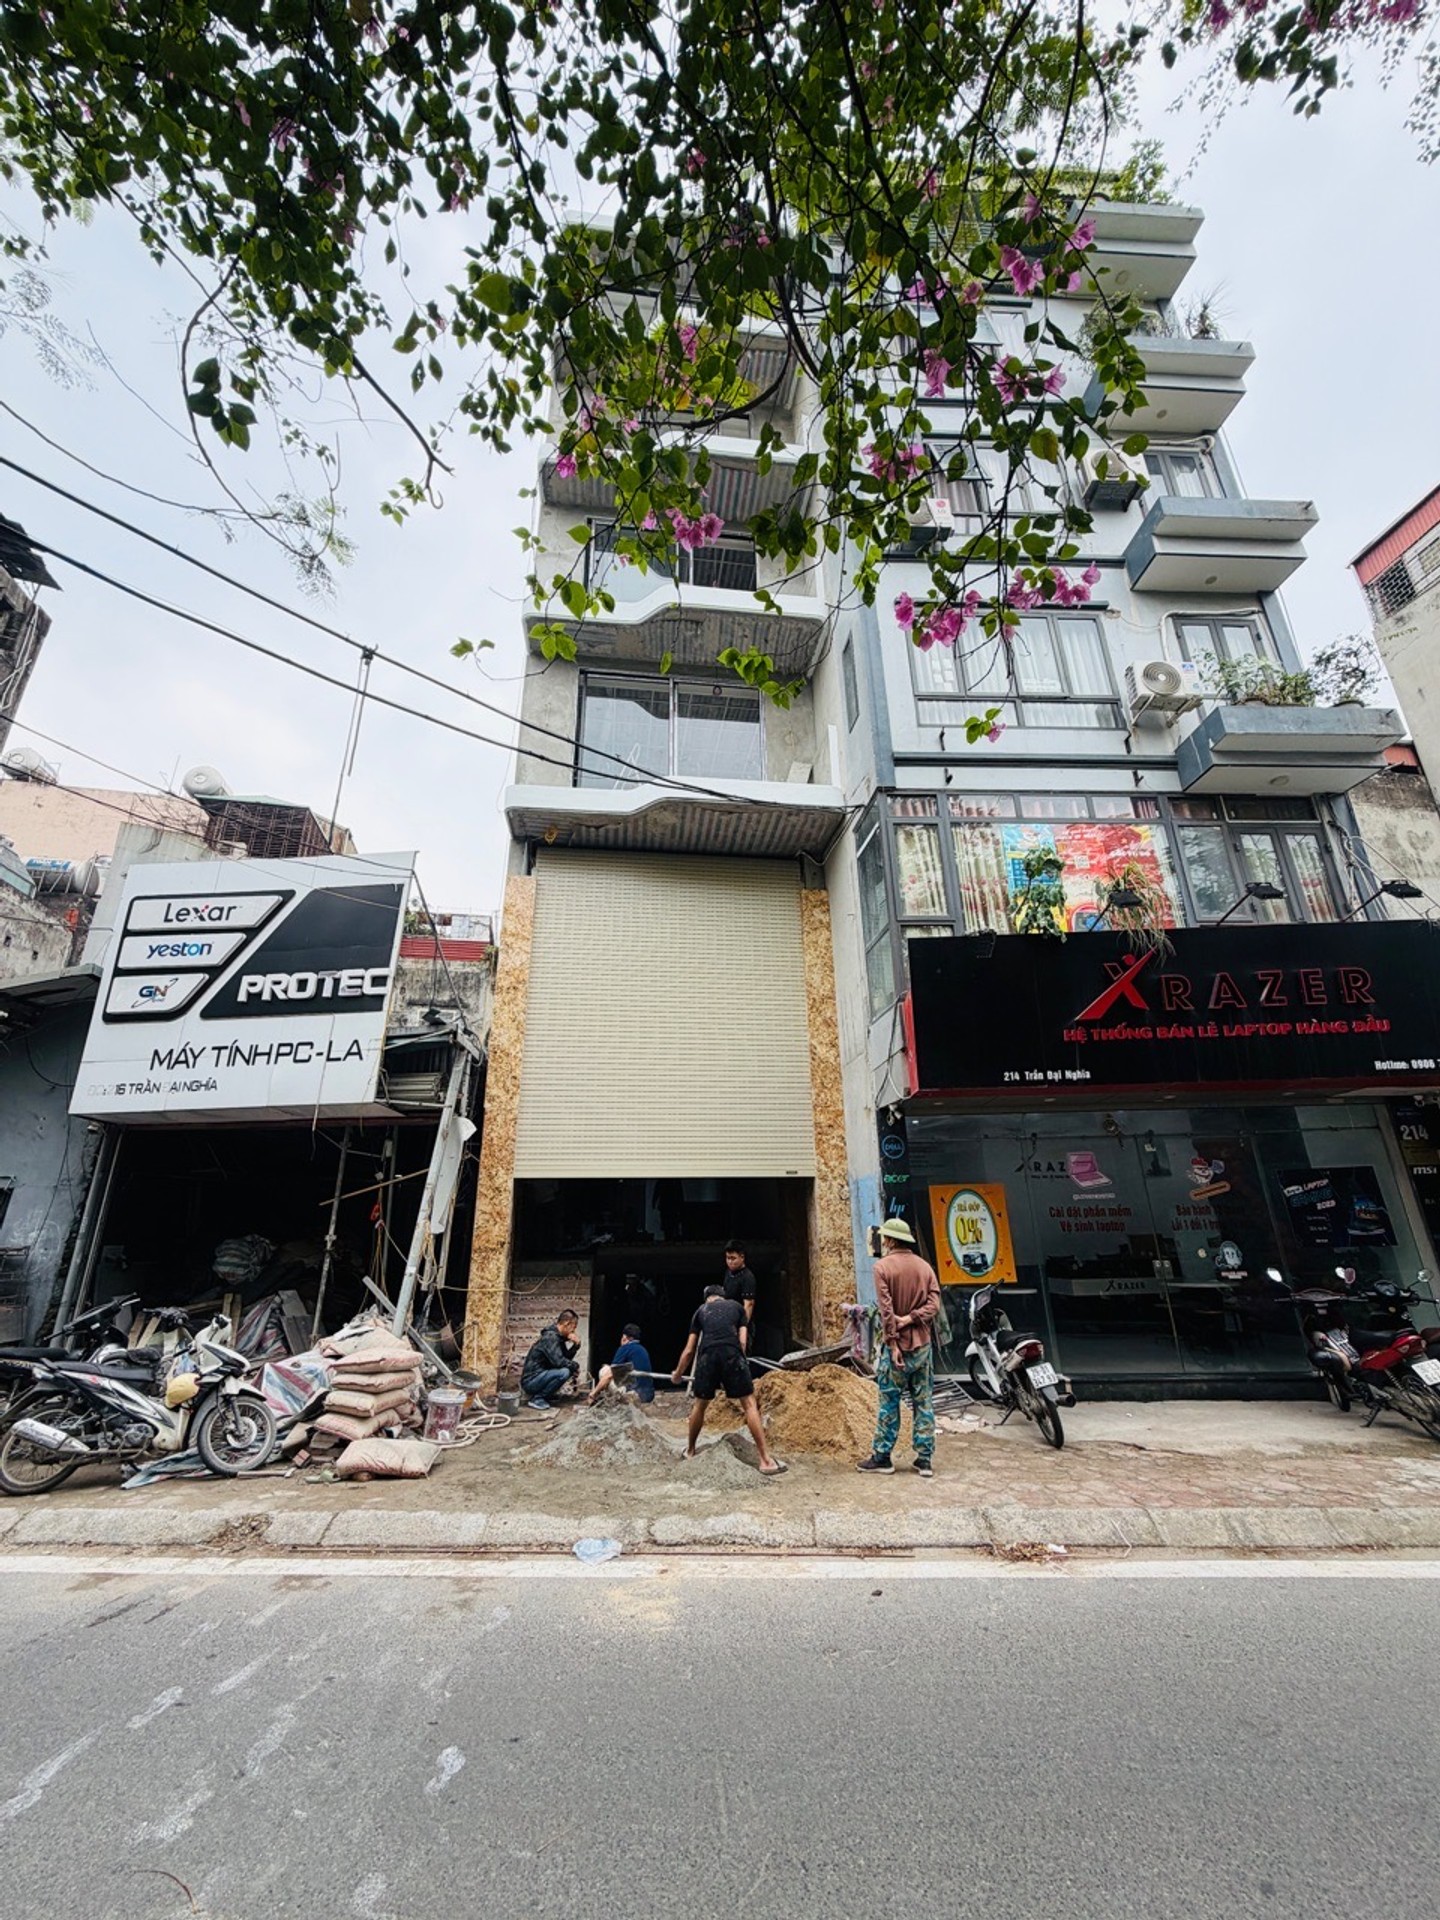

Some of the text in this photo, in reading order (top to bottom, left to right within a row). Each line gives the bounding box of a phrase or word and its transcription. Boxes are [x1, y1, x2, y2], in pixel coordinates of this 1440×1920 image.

[163, 903, 237, 923] Lexar
[147, 942, 213, 959] yeston
[1063, 1026, 1088, 1044] HỆ
[1091, 1022, 1153, 1041] THỐNG
[1156, 1023, 1195, 1039] BÁN
[1222, 1022, 1293, 1037] LAPTOP
[1296, 1018, 1350, 1035] HÀNG
[1352, 1014, 1391, 1033] ĐẦU
[149, 1039, 364, 1071] MÁY TÍNH PC-LA
[1003, 1071, 1020, 1081] 214
[128, 1077, 162, 1095] TRẦN
[181, 1076, 218, 1093] NGHĨA
[1400, 1125, 1430, 1140] 214
[883, 1173, 910, 1184] acer
[1412, 1166, 1438, 1175] msi
[955, 1214, 983, 1246] 0%
